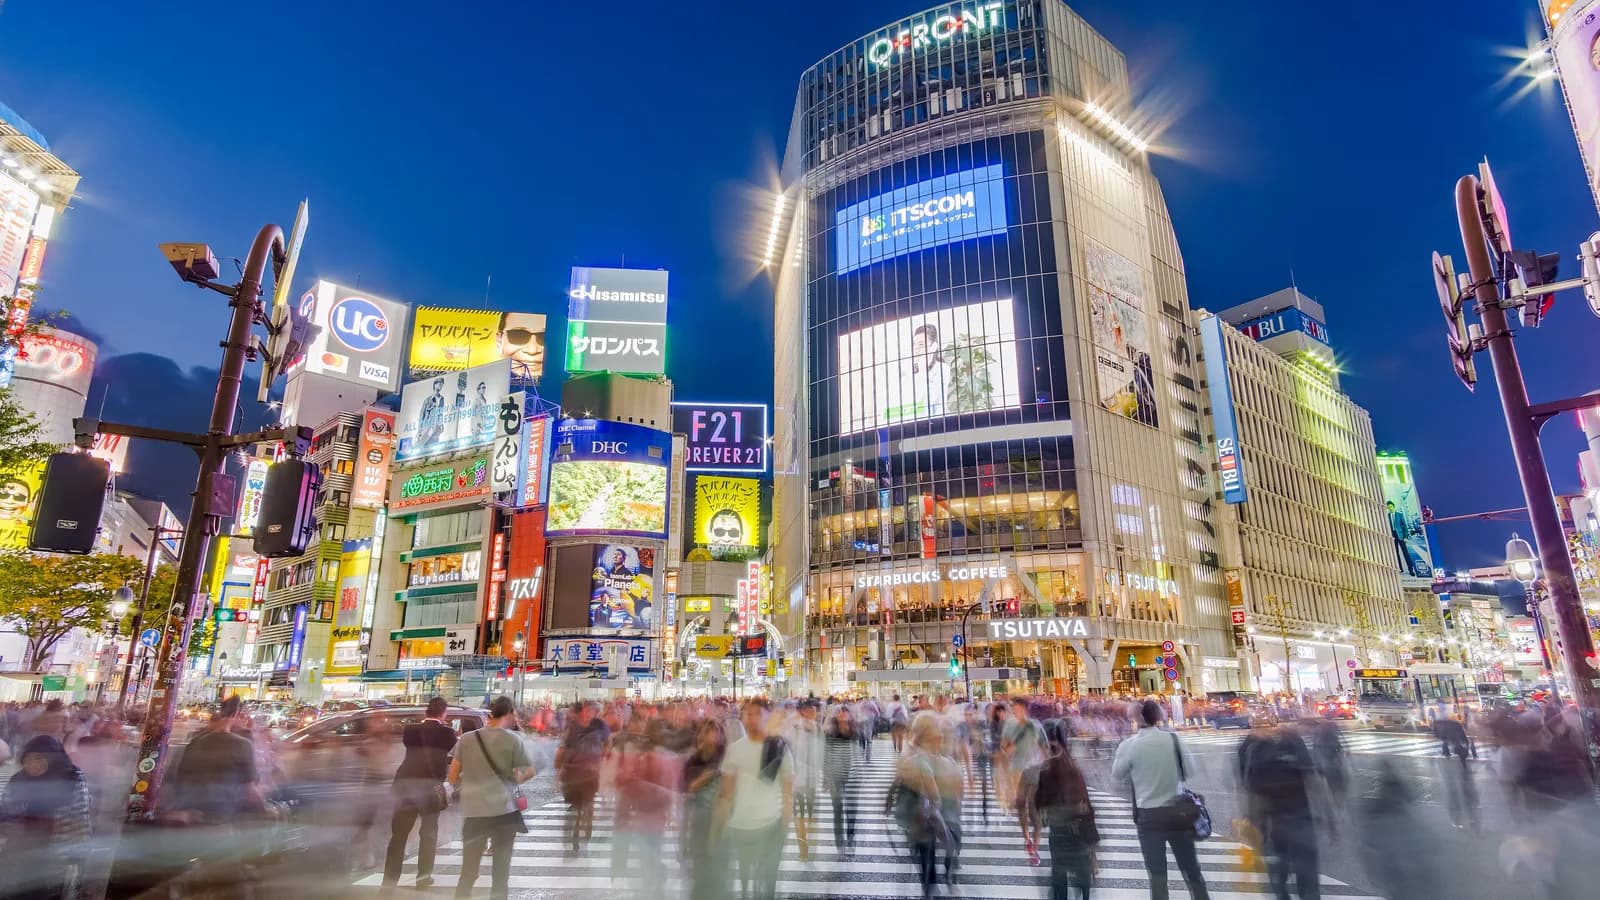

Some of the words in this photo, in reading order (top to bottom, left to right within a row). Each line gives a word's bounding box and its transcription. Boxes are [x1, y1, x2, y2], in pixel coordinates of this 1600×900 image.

[891, 191, 975, 226] ITSCOM
[570, 285, 665, 303] Hisamitsu
[336, 305, 387, 341] UC
[420, 323, 493, 342] ヤバババーン
[571, 335, 660, 357] サロンパス
[362, 365, 389, 381] VISA
[571, 424, 596, 432] Channel
[692, 410, 742, 443] F21
[492, 396, 522, 487] もんじゃ
[591, 441, 628, 454] DHC
[745, 447, 761, 464] 21
[1217, 437, 1240, 492] SEIBU
[700, 480, 754, 497] ヤバババーン
[705, 493, 748, 506] ヤバババーン
[411, 571, 460, 586] Euphoria
[858, 570, 940, 588] STARBUCKS
[948, 566, 1008, 581] COFFEE
[990, 619, 1088, 638] TSUTAYA
[552, 643, 646, 662] 大盛堂店
